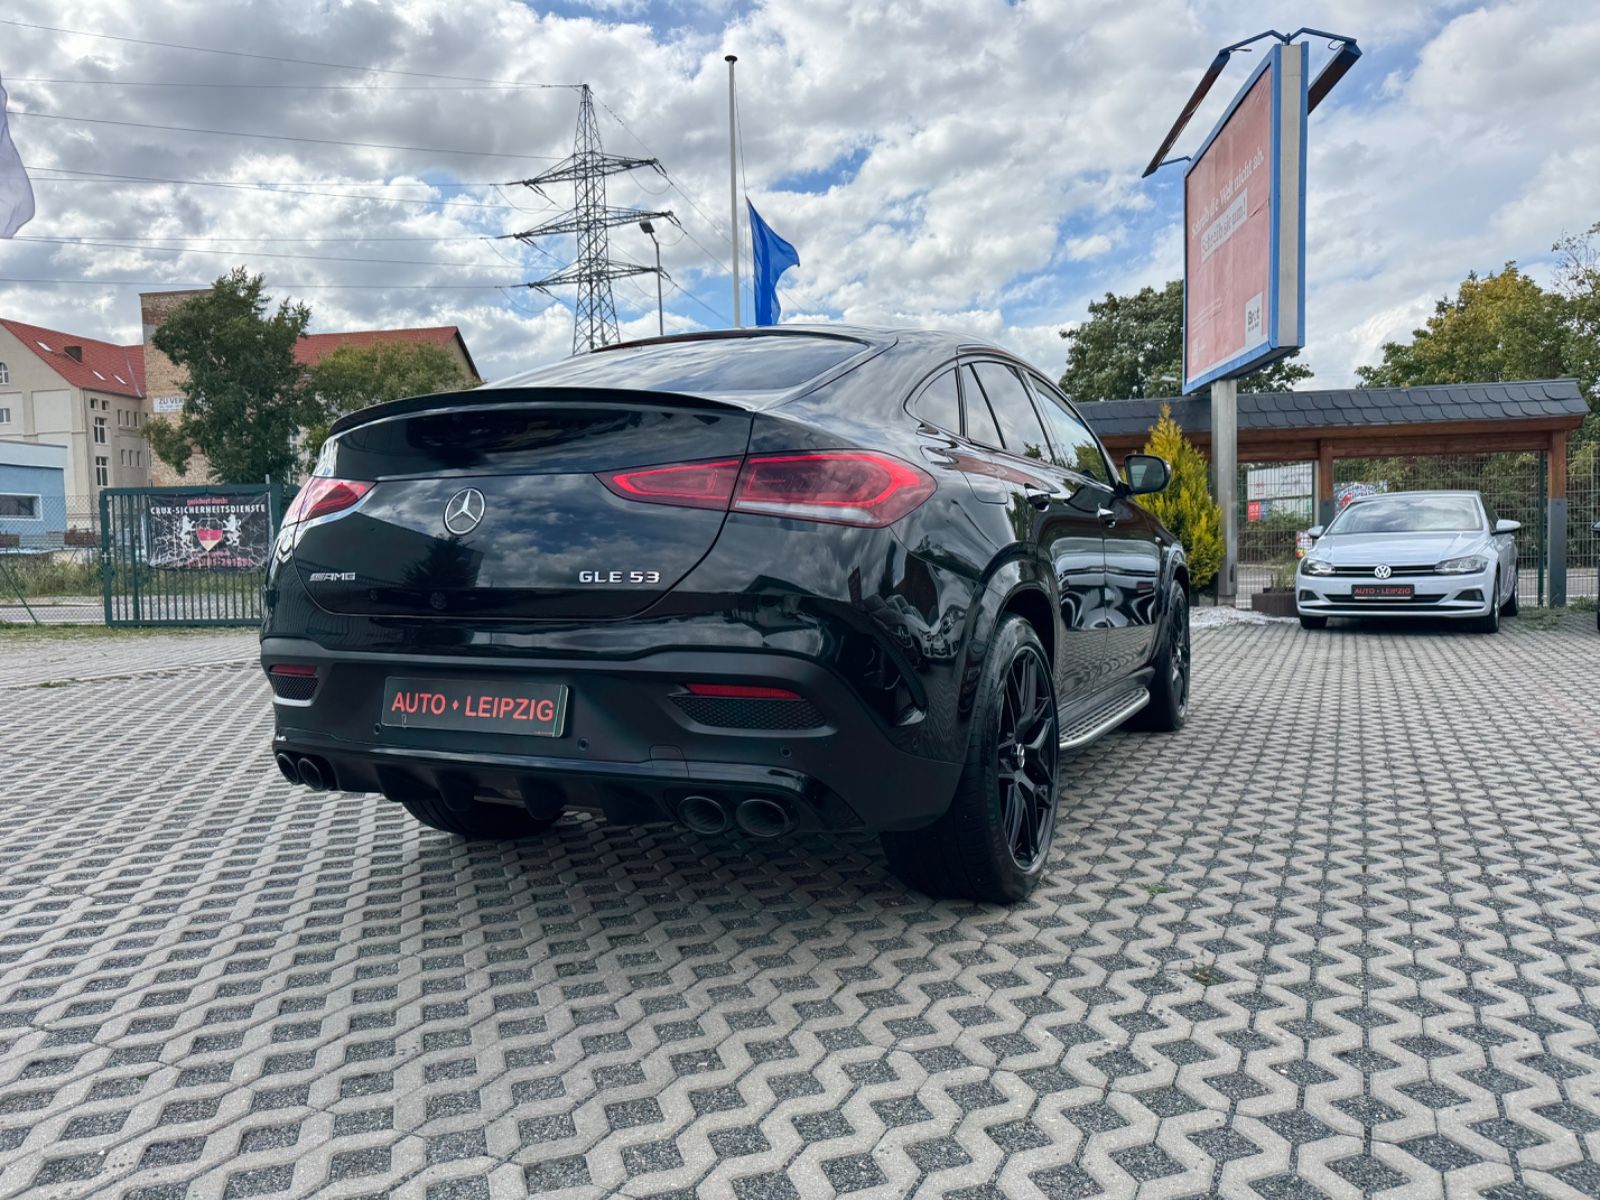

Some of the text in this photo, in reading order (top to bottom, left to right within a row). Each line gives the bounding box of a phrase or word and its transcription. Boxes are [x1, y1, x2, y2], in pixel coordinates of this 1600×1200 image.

[323, 571, 356, 582] AMG
[578, 570, 660, 583] GLE 53
[391, 692, 554, 722] AUTO LEIPZIG
